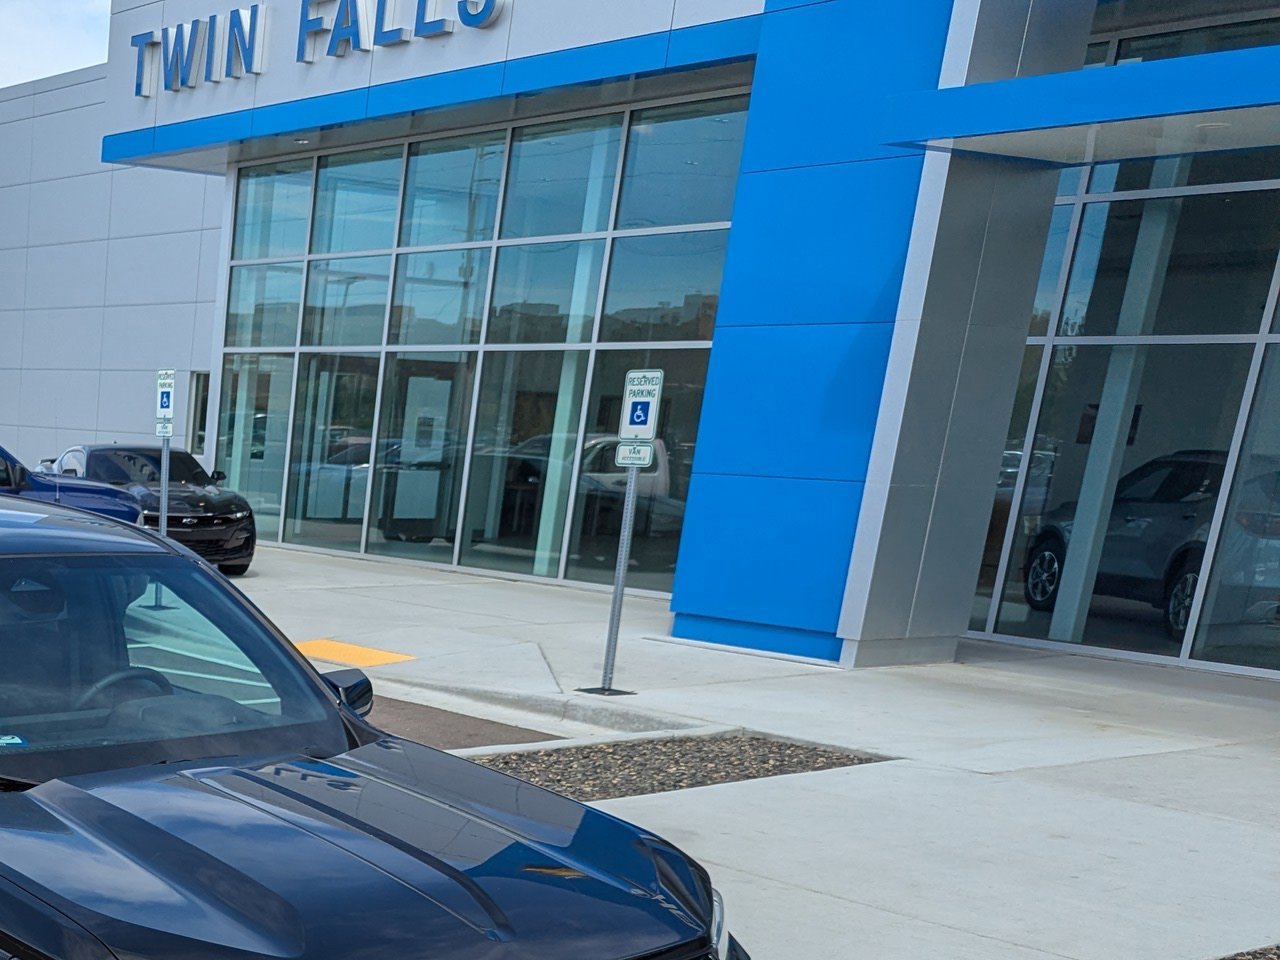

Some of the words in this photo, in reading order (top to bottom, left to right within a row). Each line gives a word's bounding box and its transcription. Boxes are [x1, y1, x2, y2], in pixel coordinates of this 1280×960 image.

[131, 4, 263, 97] TWIN
[628, 376, 660, 386] RESERVED
[628, 389, 656, 398] PARKING
